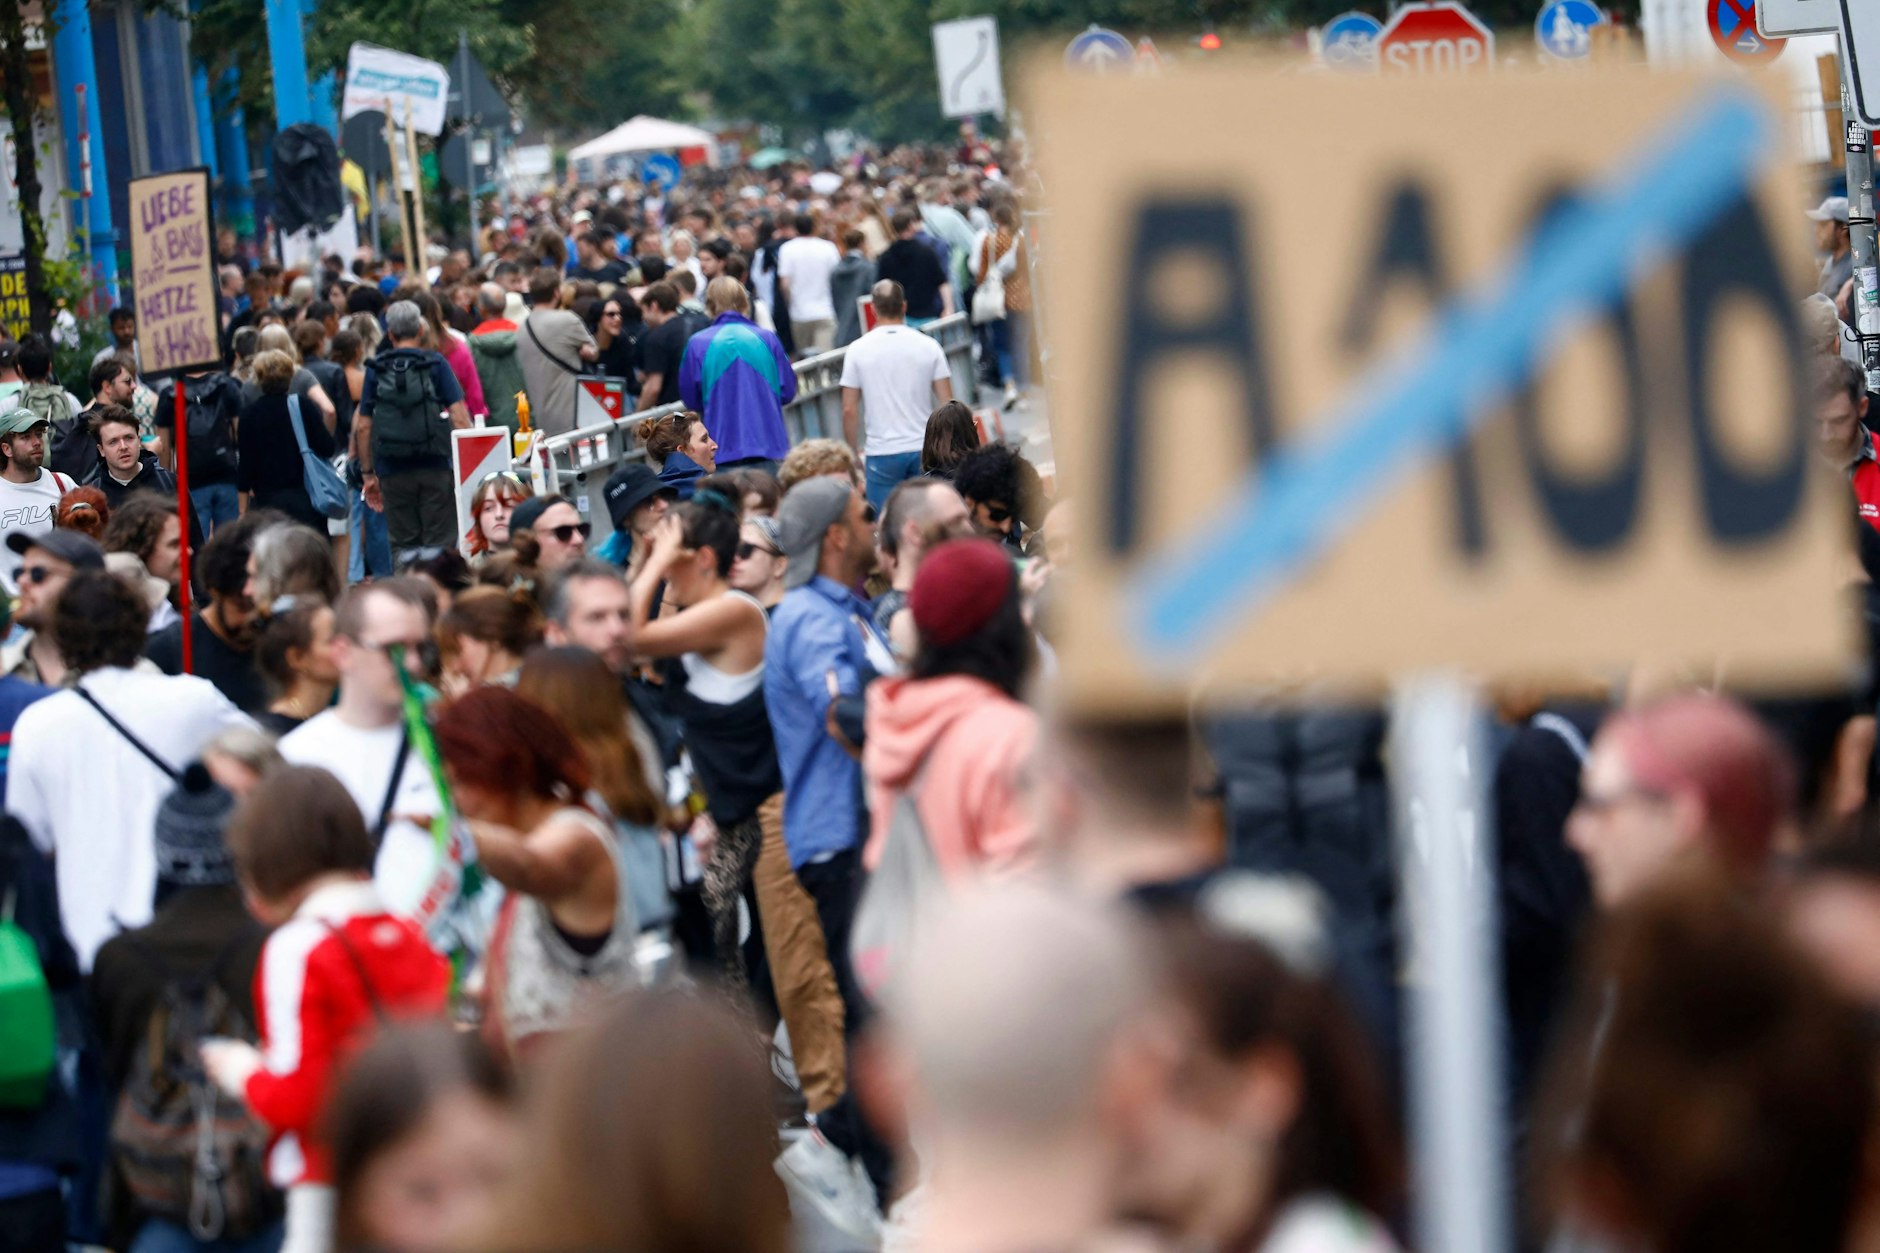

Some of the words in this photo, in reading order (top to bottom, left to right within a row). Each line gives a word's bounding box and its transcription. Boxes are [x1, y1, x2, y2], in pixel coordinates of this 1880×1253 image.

[1386, 37, 1481, 73] STOP
[141, 183, 195, 233] LIEBE
[166, 220, 204, 260] BASS
[140, 283, 198, 327] HETZE
[165, 317, 212, 368] HASS
[1103, 172, 1812, 564] A100
